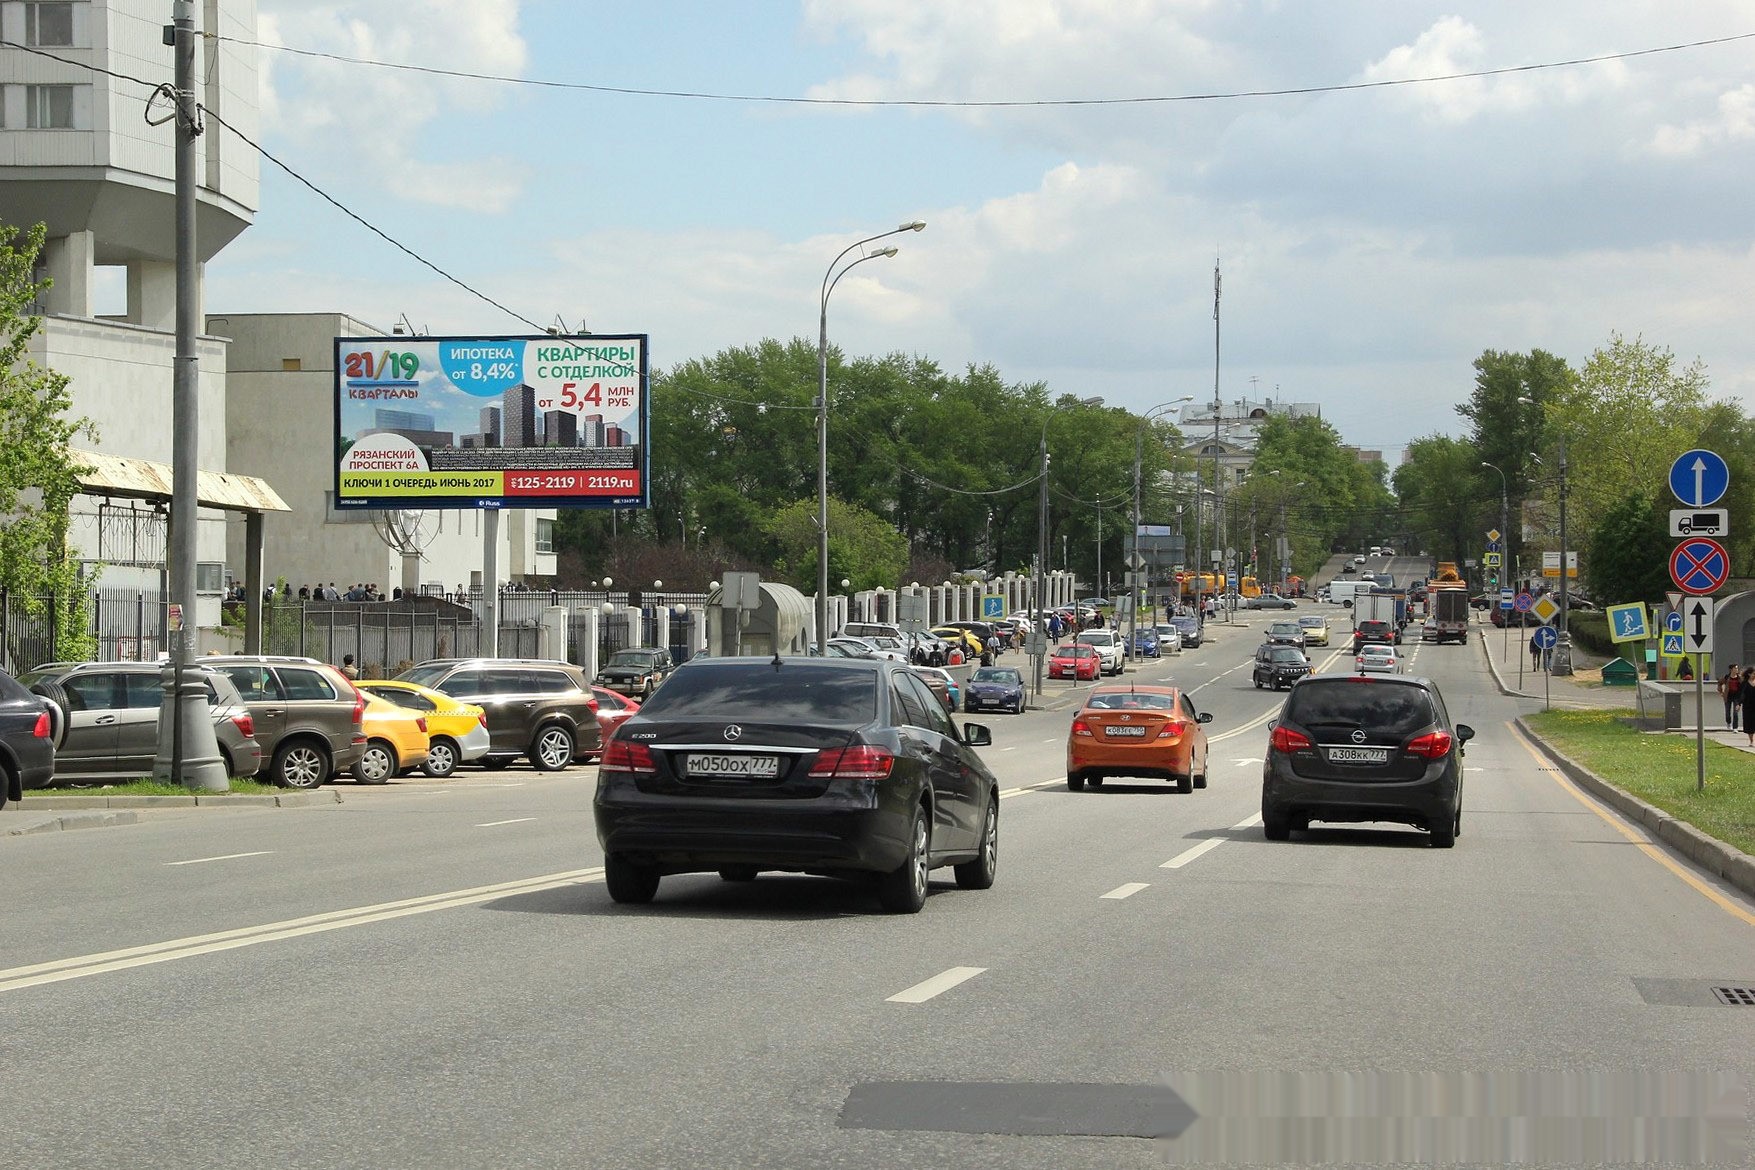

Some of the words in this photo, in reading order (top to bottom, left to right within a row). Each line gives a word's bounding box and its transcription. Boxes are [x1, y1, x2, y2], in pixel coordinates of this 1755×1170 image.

[451, 347, 514, 360] ИПОТЕКА
[537, 347, 635, 361] КВАРТИРЫ
[345, 350, 419, 380] 21/19
[452, 370, 466, 380] от
[537, 366, 548, 379] С
[551, 363, 634, 381] ОТДЕЛКОЙ
[349, 389, 419, 400] КВАРТАЛЫ
[538, 399, 553, 408] от
[560, 383, 602, 411] 5,4
[608, 387, 634, 396] МЛН
[608, 398, 631, 407] РУБ.
[353, 449, 415, 460] РЯЗАНСКИЙ
[349, 461, 404, 470] ПРОСПЕКТ
[406, 461, 419, 470] 6А
[344, 478, 382, 488] КЛЮЧИ
[385, 478, 391, 488] 1
[393, 478, 437, 489] ОЧЕРЕДЬ
[440, 478, 471, 488] ИЮНЬ
[473, 478, 495, 488] 2017
[518, 477, 575, 488] 125-2119
[588, 476, 633, 488] 2119.ru
[1331, 749, 1369, 760] А308КК
[1370, 749, 1385, 757] 777
[690, 757, 749, 772] М050ОХ
[752, 757, 774, 769] 777
